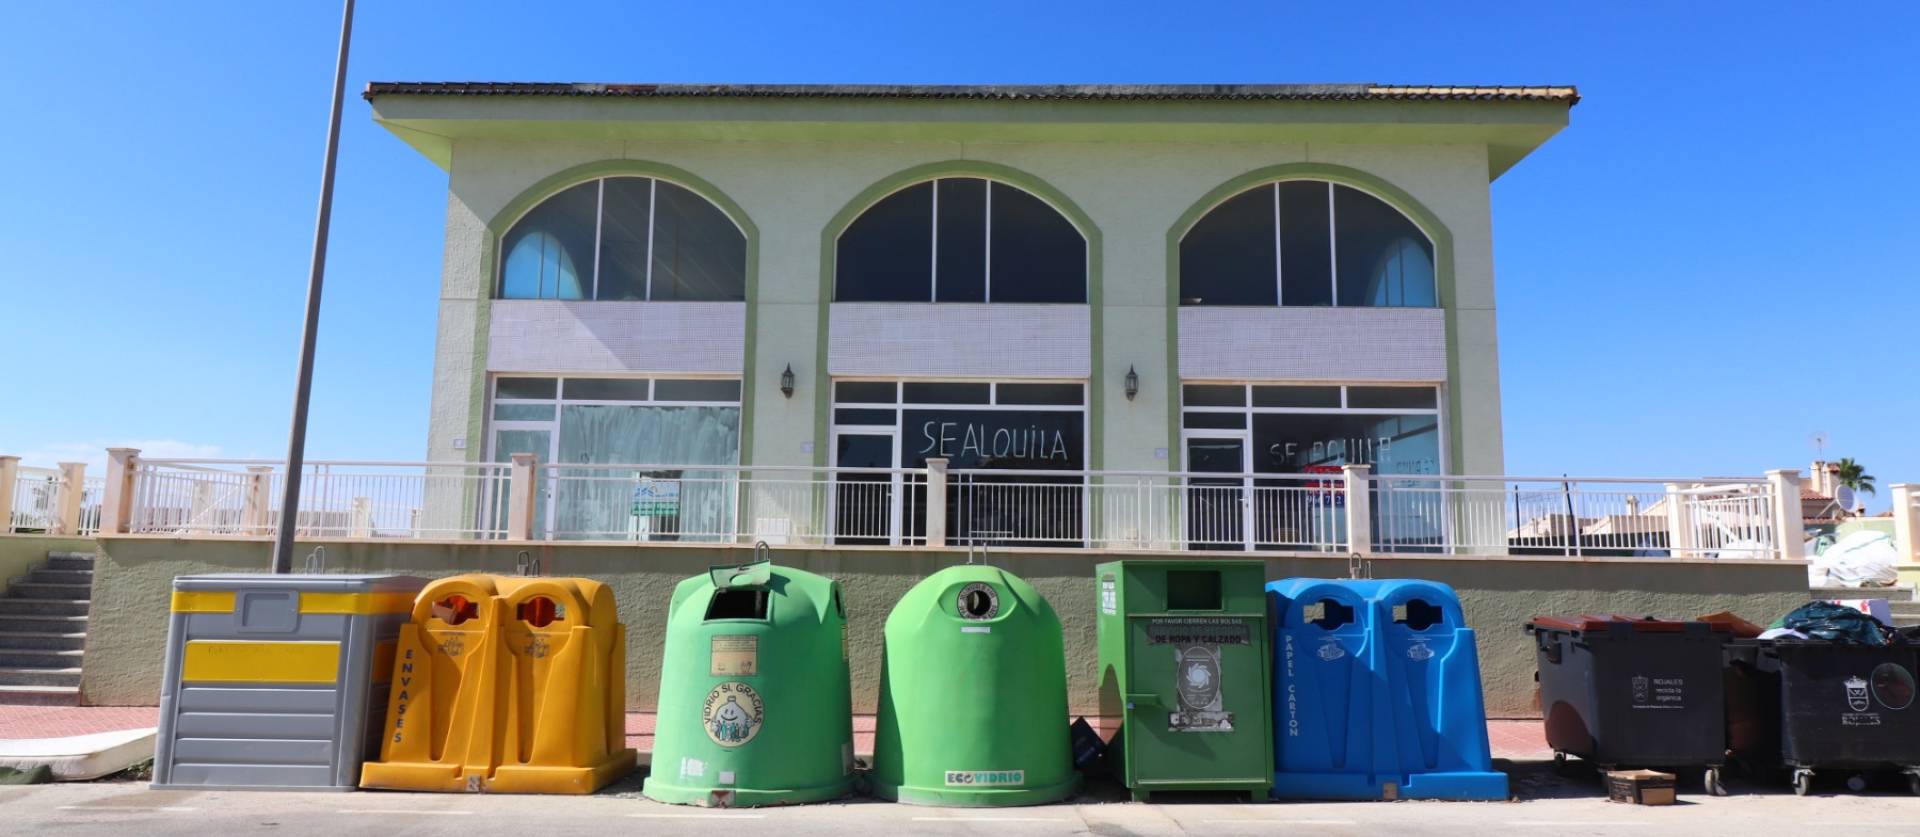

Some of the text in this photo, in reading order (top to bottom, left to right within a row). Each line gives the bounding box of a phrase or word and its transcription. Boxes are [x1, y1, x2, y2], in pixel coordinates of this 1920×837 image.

[1155, 634, 1242, 644] DE ROPA Y CALZADO
[393, 648, 414, 743] ENVASES
[703, 689, 720, 725] VIDRIO
[735, 683, 762, 725] GRACIAS
[1285, 635, 1298, 737] PAPEL CARTON
[946, 771, 1022, 784] ECOVIDRIO
